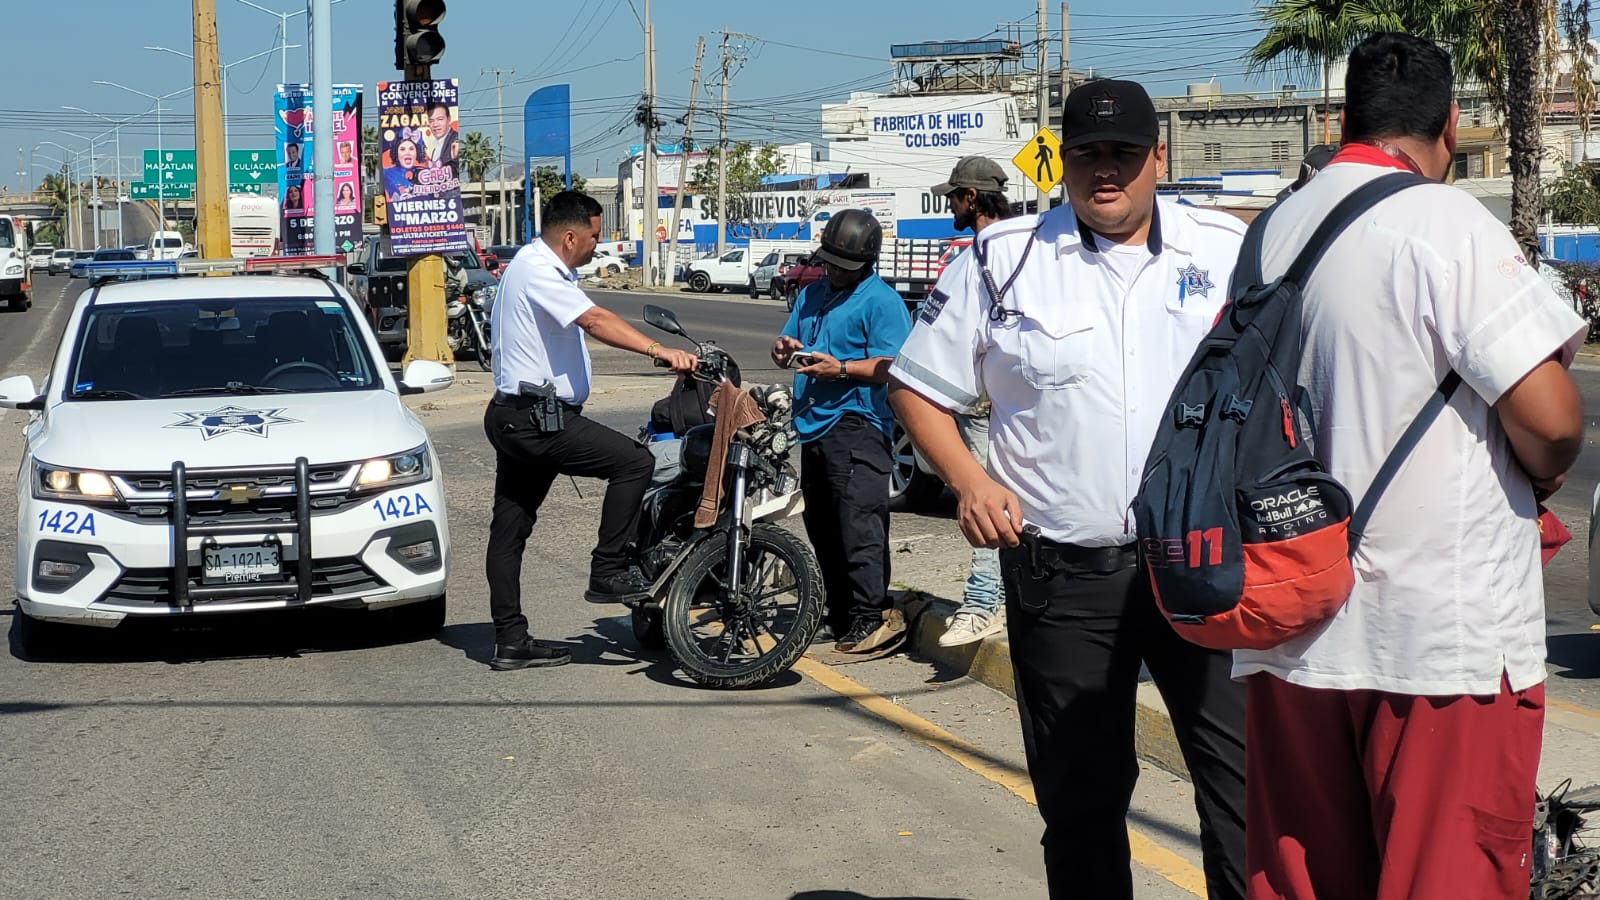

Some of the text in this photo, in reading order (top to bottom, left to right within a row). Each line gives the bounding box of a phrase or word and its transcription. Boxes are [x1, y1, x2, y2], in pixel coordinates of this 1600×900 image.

[389, 81, 446, 92] CENTRO DE
[381, 89, 456, 100] CONVENCIONES
[380, 113, 430, 128] ZAGAR
[873, 112, 983, 131] FABRICA DE HIELO
[393, 198, 457, 213] VIERNES 6
[300, 218, 314, 227] DE
[394, 210, 458, 225] DE MARZO
[391, 226, 422, 234] BOLETOS
[424, 224, 445, 232] DESDE
[1250, 486, 1320, 511] ORACLE
[373, 492, 432, 522] 142A
[38, 509, 96, 537] 142A
[1258, 511, 1327, 534] RACING
[1186, 527, 1223, 568] 11
[206, 551, 280, 571] SA-142A-3
[225, 571, 261, 583] Premier
